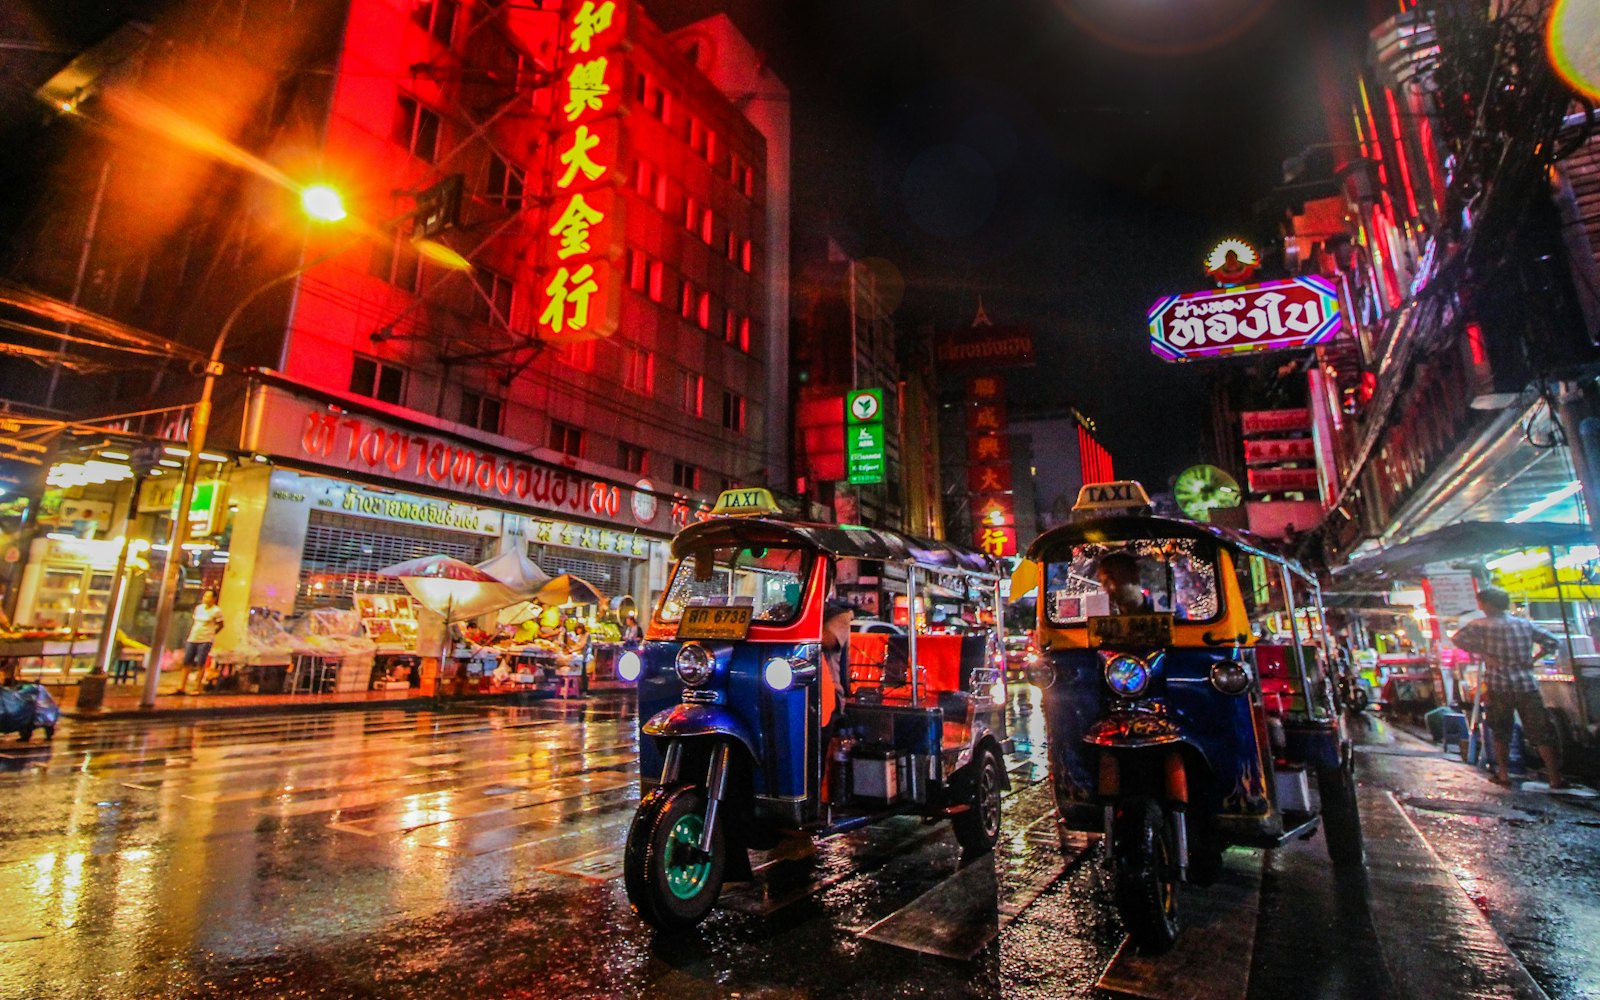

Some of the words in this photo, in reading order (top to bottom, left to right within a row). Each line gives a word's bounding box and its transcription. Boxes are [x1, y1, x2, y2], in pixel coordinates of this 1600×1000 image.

[1168, 292, 1321, 347] ทองใบ
[723, 492, 760, 508] TAXI
[1088, 485, 1133, 501] TAXI
[714, 610, 747, 624] 6738
